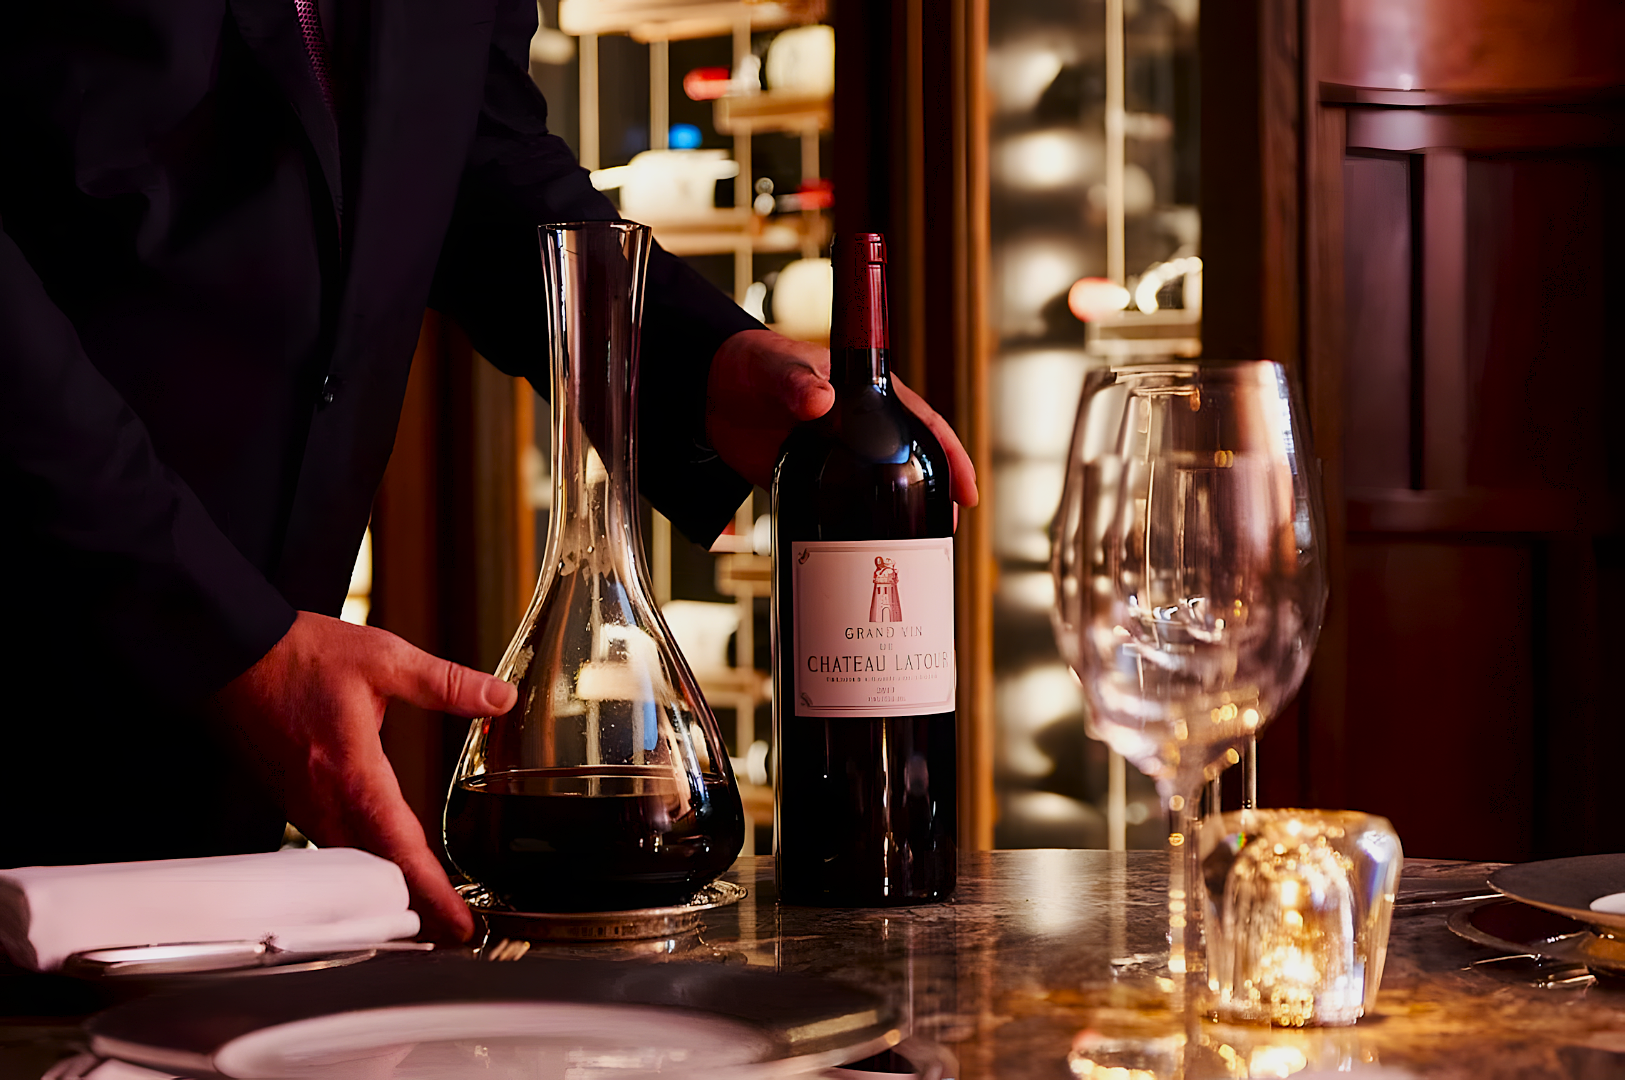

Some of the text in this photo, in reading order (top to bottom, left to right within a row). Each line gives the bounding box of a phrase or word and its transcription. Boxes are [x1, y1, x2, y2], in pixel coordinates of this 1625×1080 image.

[844, 625, 923, 640] GRAND VIN
[807, 651, 949, 673] CHATEAU LATOUR
